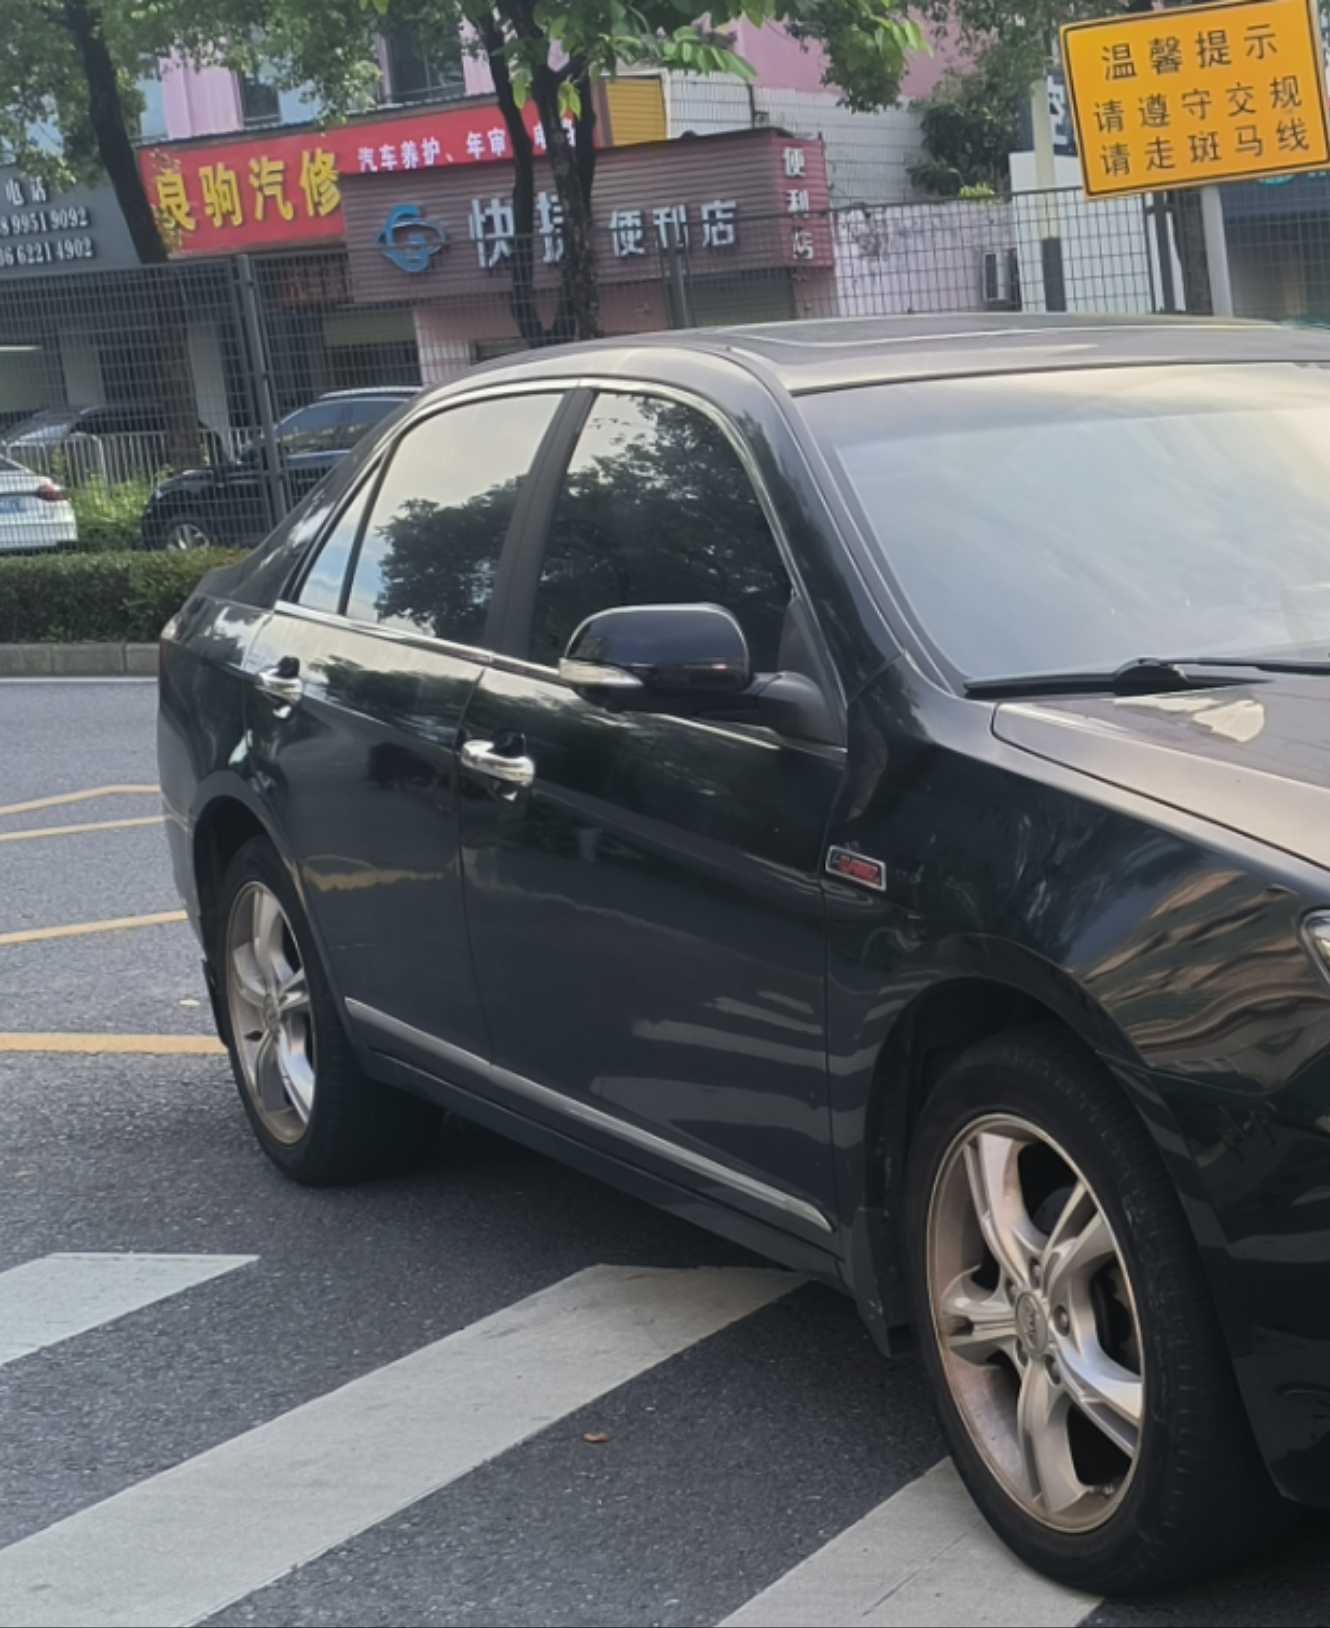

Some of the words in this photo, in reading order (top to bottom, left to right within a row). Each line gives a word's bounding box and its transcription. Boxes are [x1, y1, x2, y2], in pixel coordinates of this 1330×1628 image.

[1101, 23, 1278, 81] 温馨提示
[1093, 75, 1302, 134] 请遵守交规
[1100, 119, 1309, 177] 请走斑马线
